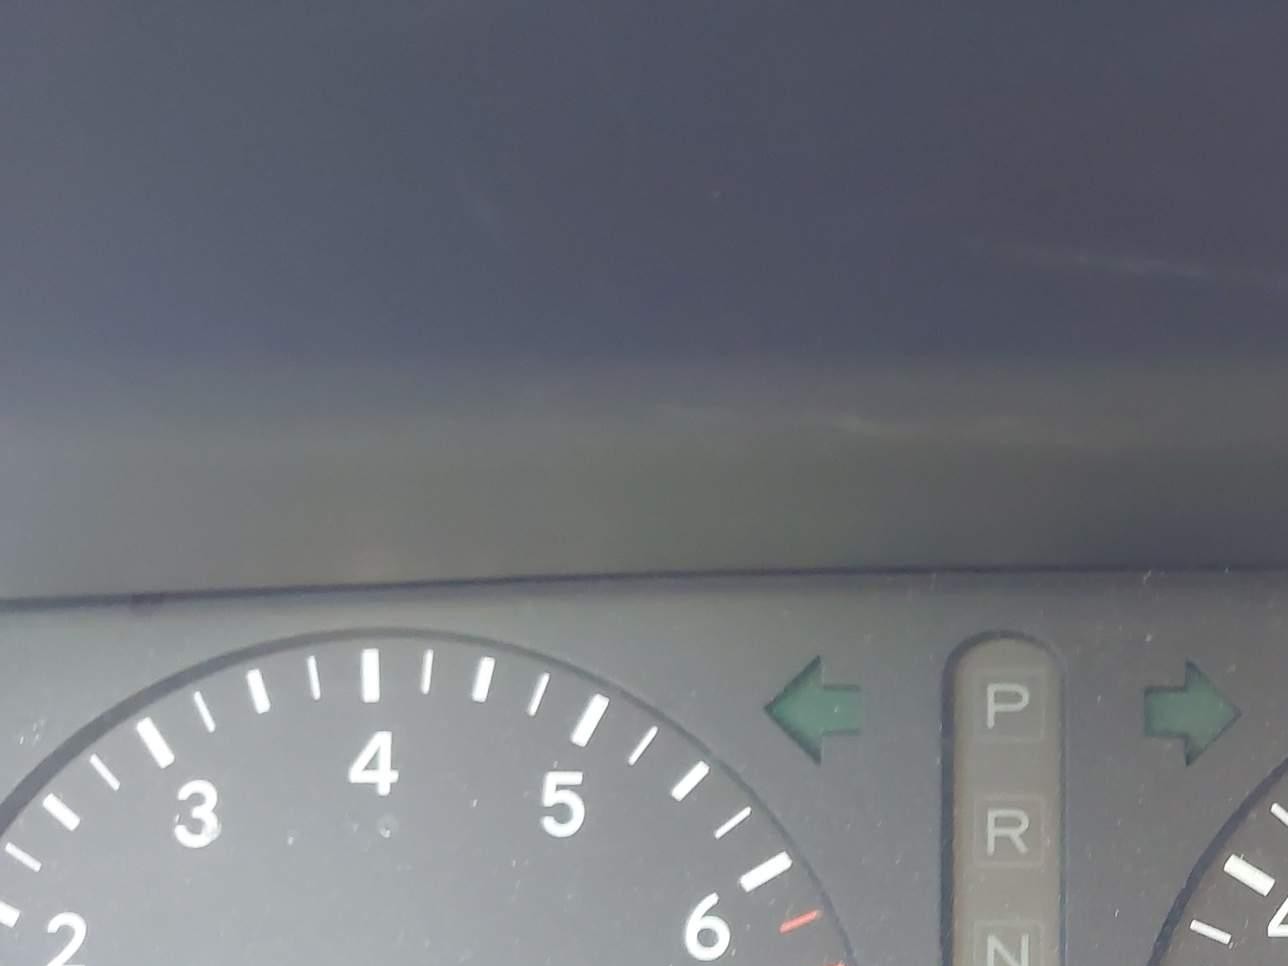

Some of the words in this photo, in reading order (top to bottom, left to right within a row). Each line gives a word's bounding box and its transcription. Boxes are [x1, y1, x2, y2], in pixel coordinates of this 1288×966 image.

[986, 683, 1030, 729] P
[348, 730, 399, 796] 4
[173, 779, 221, 849] 3
[541, 771, 585, 838] 5
[986, 809, 1029, 855] R
[684, 892, 731, 961] 6
